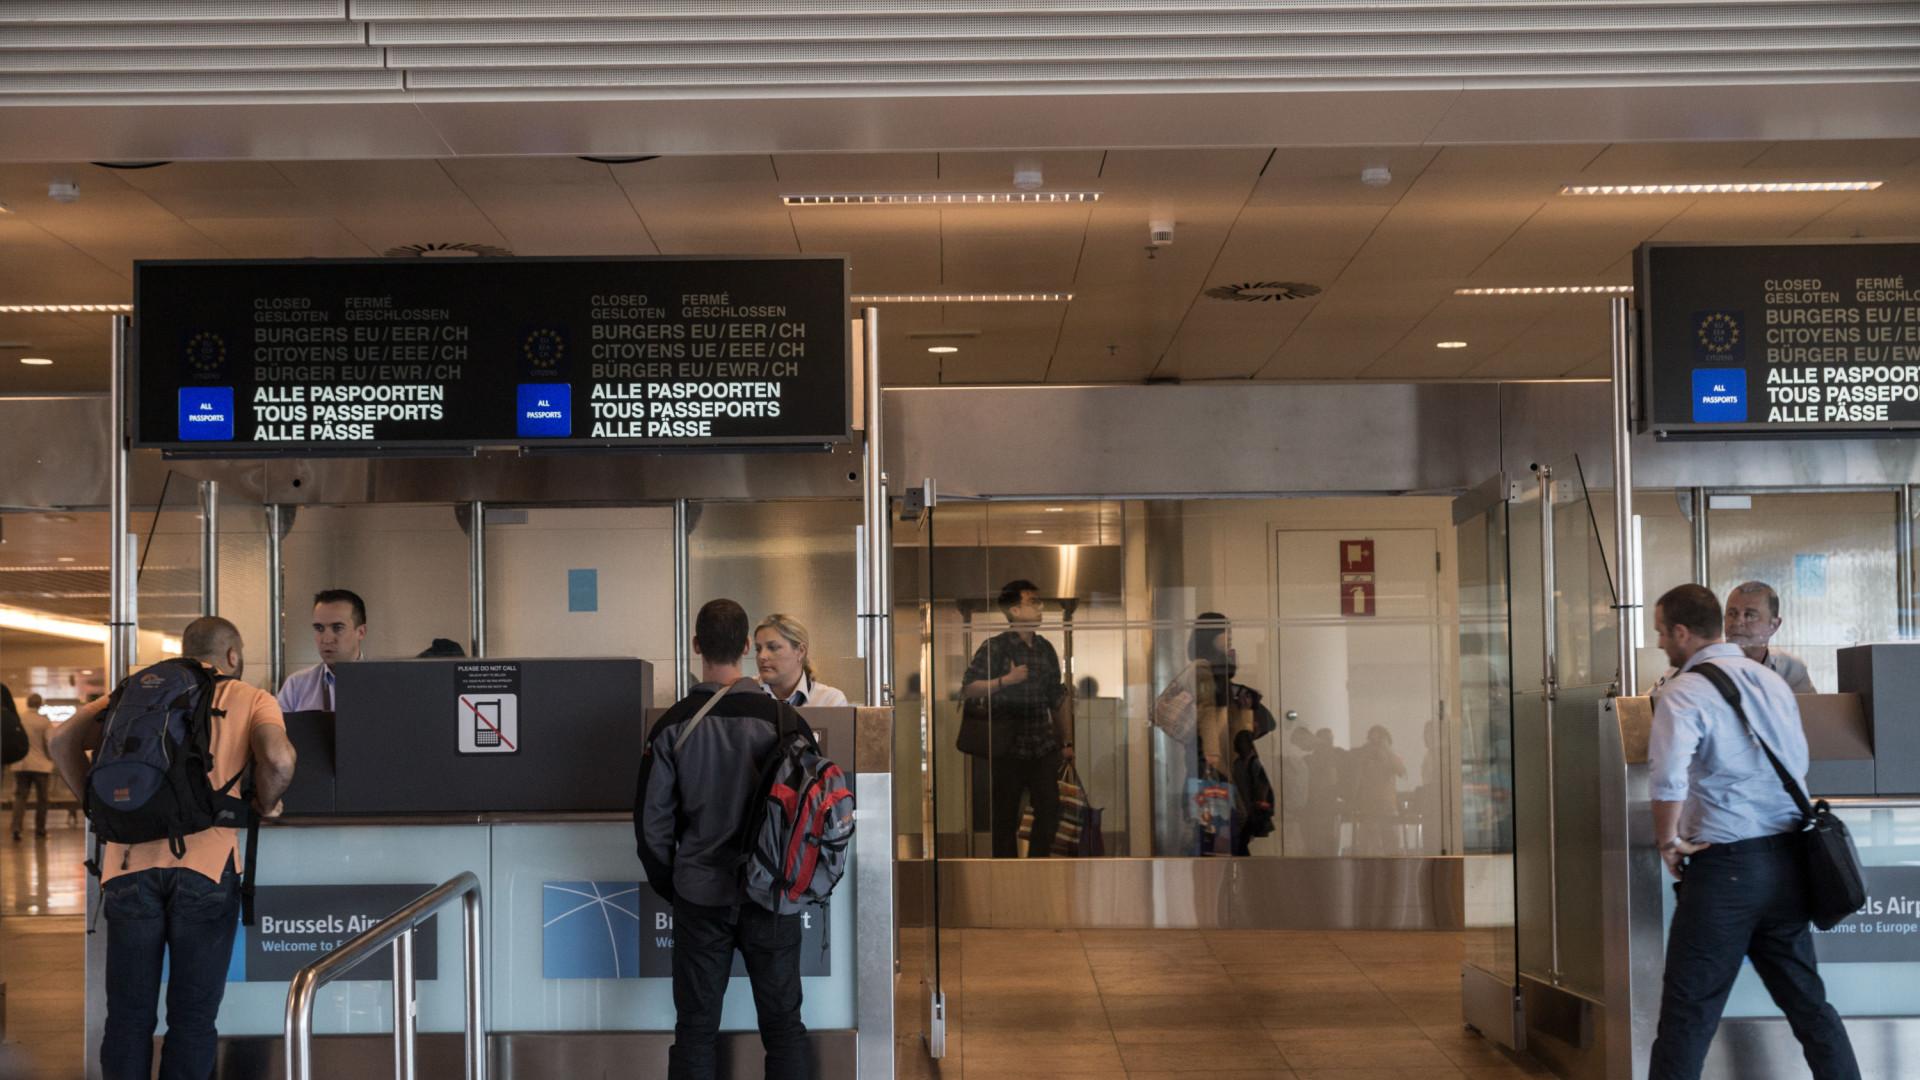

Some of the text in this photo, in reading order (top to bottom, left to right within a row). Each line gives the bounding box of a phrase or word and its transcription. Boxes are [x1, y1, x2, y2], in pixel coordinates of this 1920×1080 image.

[1764, 279, 1822, 291] CLOSED
[1856, 275, 1904, 289] FERMÉ
[254, 298, 311, 309] CLOSED
[344, 295, 392, 308] FERMÉ
[591, 295, 647, 306] CLOSED
[682, 291, 729, 305] FERMÉ
[1765, 292, 1839, 304] GESLOTEN
[254, 311, 328, 322] GESLOTEN
[345, 309, 449, 321] GESCHLOSSEN
[591, 308, 665, 320] GESLOTEN
[682, 306, 786, 318] GESCHLOSSEN
[1766, 308, 1860, 325] BURGERS
[254, 327, 348, 343] BURGERS
[591, 324, 685, 339] BURGERS
[1766, 327, 1861, 344] CITOYENS
[254, 347, 348, 362] CITOYENS
[591, 343, 685, 359] CITOYENS
[1768, 344, 1848, 363] BÜRGER
[254, 363, 335, 381] BÜRGER
[591, 360, 673, 378] BÜRGER
[1767, 366, 1920, 384] ALLE PASPOOR
[254, 385, 443, 402] ALLE PASPOORTEN
[591, 382, 781, 399] ALLE PASPOORTEN
[1767, 385, 1920, 403] TOUS PASSEPO
[1703, 396, 1738, 404] PASSPORTS
[253, 404, 443, 422] TOUS PASSEPORTS
[527, 411, 562, 419] PASSPORTS
[591, 401, 780, 419] TOUS PASSEPORTS
[1768, 402, 1889, 422] ALLE PÄSSE
[254, 422, 374, 441] ALLE PÄSSE
[591, 418, 712, 438] ALLE PÄSSE
[262, 915, 344, 934] Brussels
[1860, 923, 1873, 933] to
[1876, 922, 1918, 934] Europe
[262, 940, 316, 952] Welcome
[320, 941, 333, 951] to
